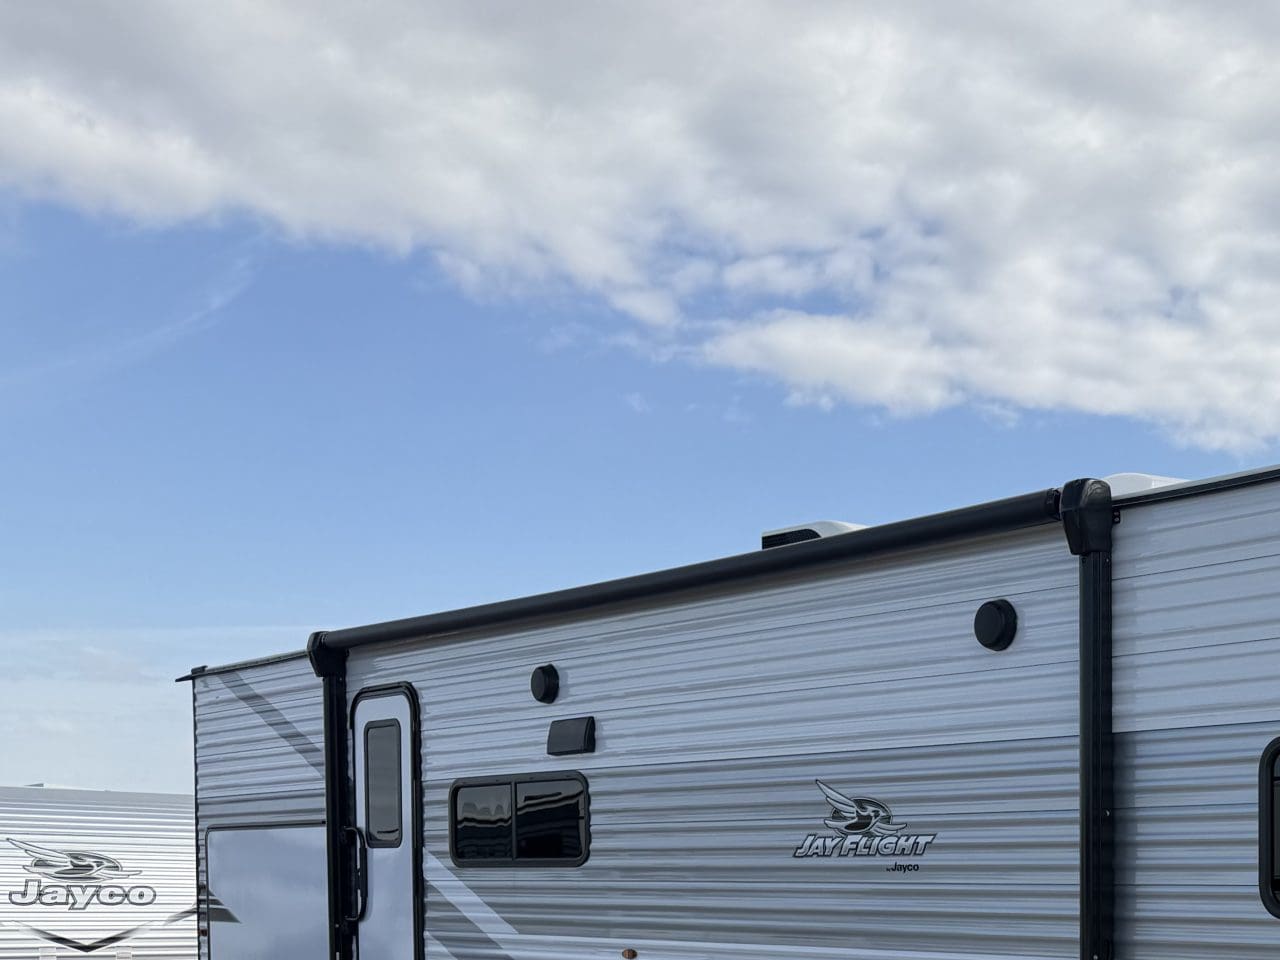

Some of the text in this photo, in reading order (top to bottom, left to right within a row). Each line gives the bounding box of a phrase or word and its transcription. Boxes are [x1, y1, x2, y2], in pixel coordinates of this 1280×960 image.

[793, 834, 937, 858] JAY FLIGHT
[891, 861, 920, 874] Jayco
[9, 879, 156, 910] Jayco
